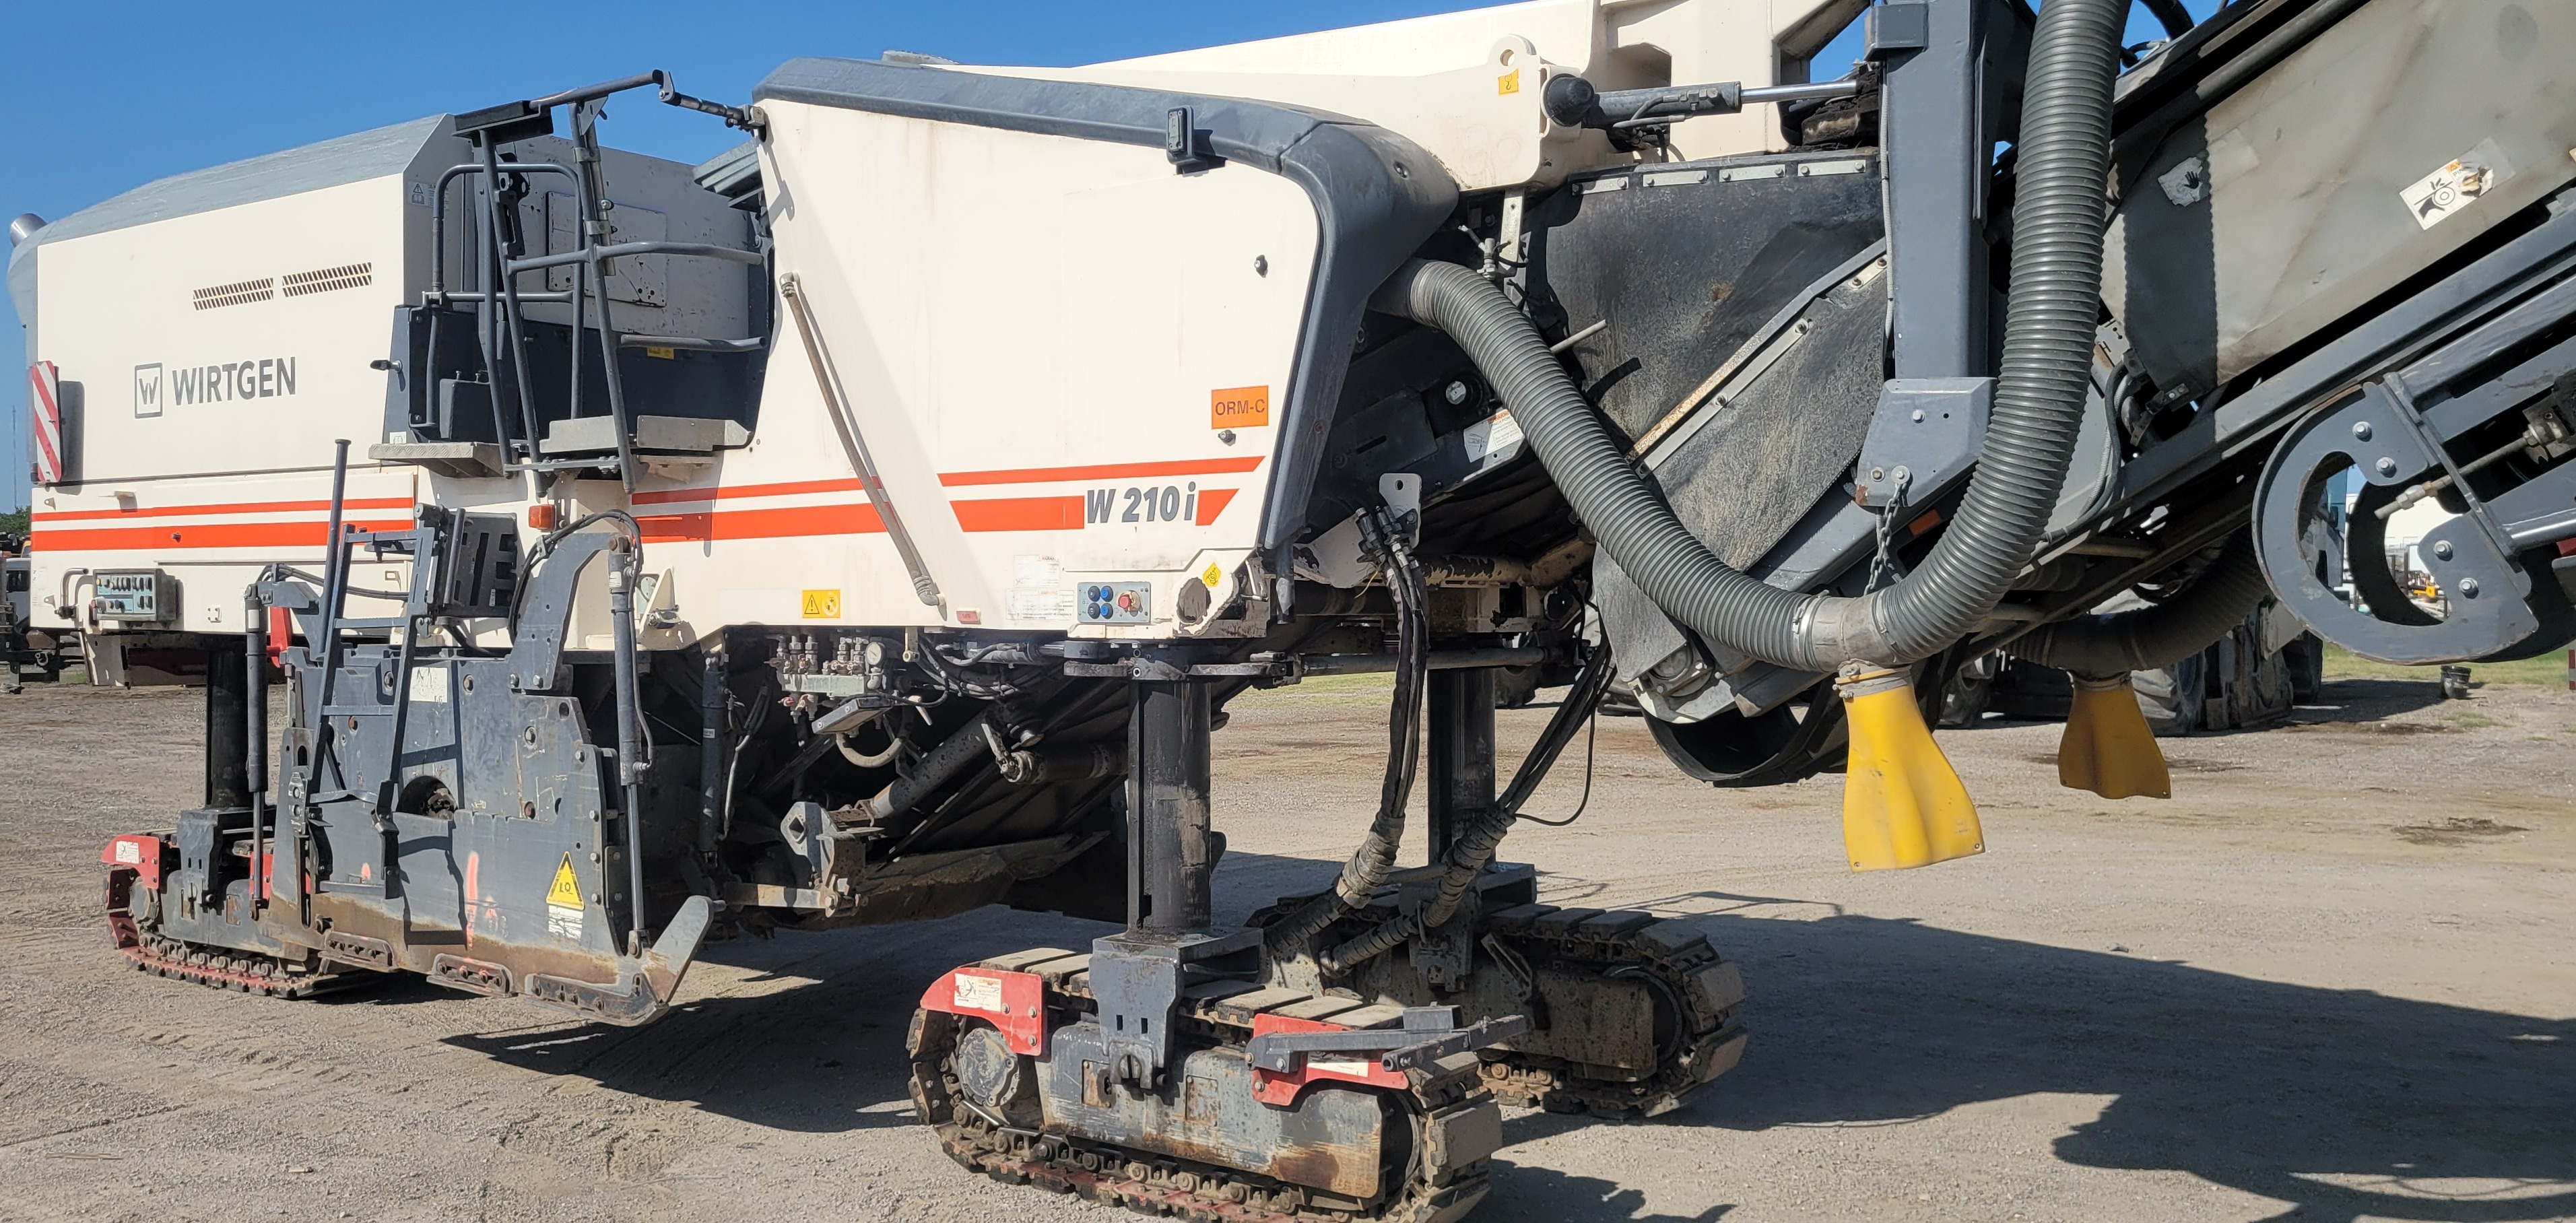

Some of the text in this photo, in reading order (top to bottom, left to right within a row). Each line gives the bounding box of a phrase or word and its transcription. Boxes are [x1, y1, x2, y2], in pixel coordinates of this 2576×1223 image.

[172, 356, 296, 406] WIRTGEN
[1215, 399, 1265, 416] ORM-C
[1087, 488, 1117, 524] W
